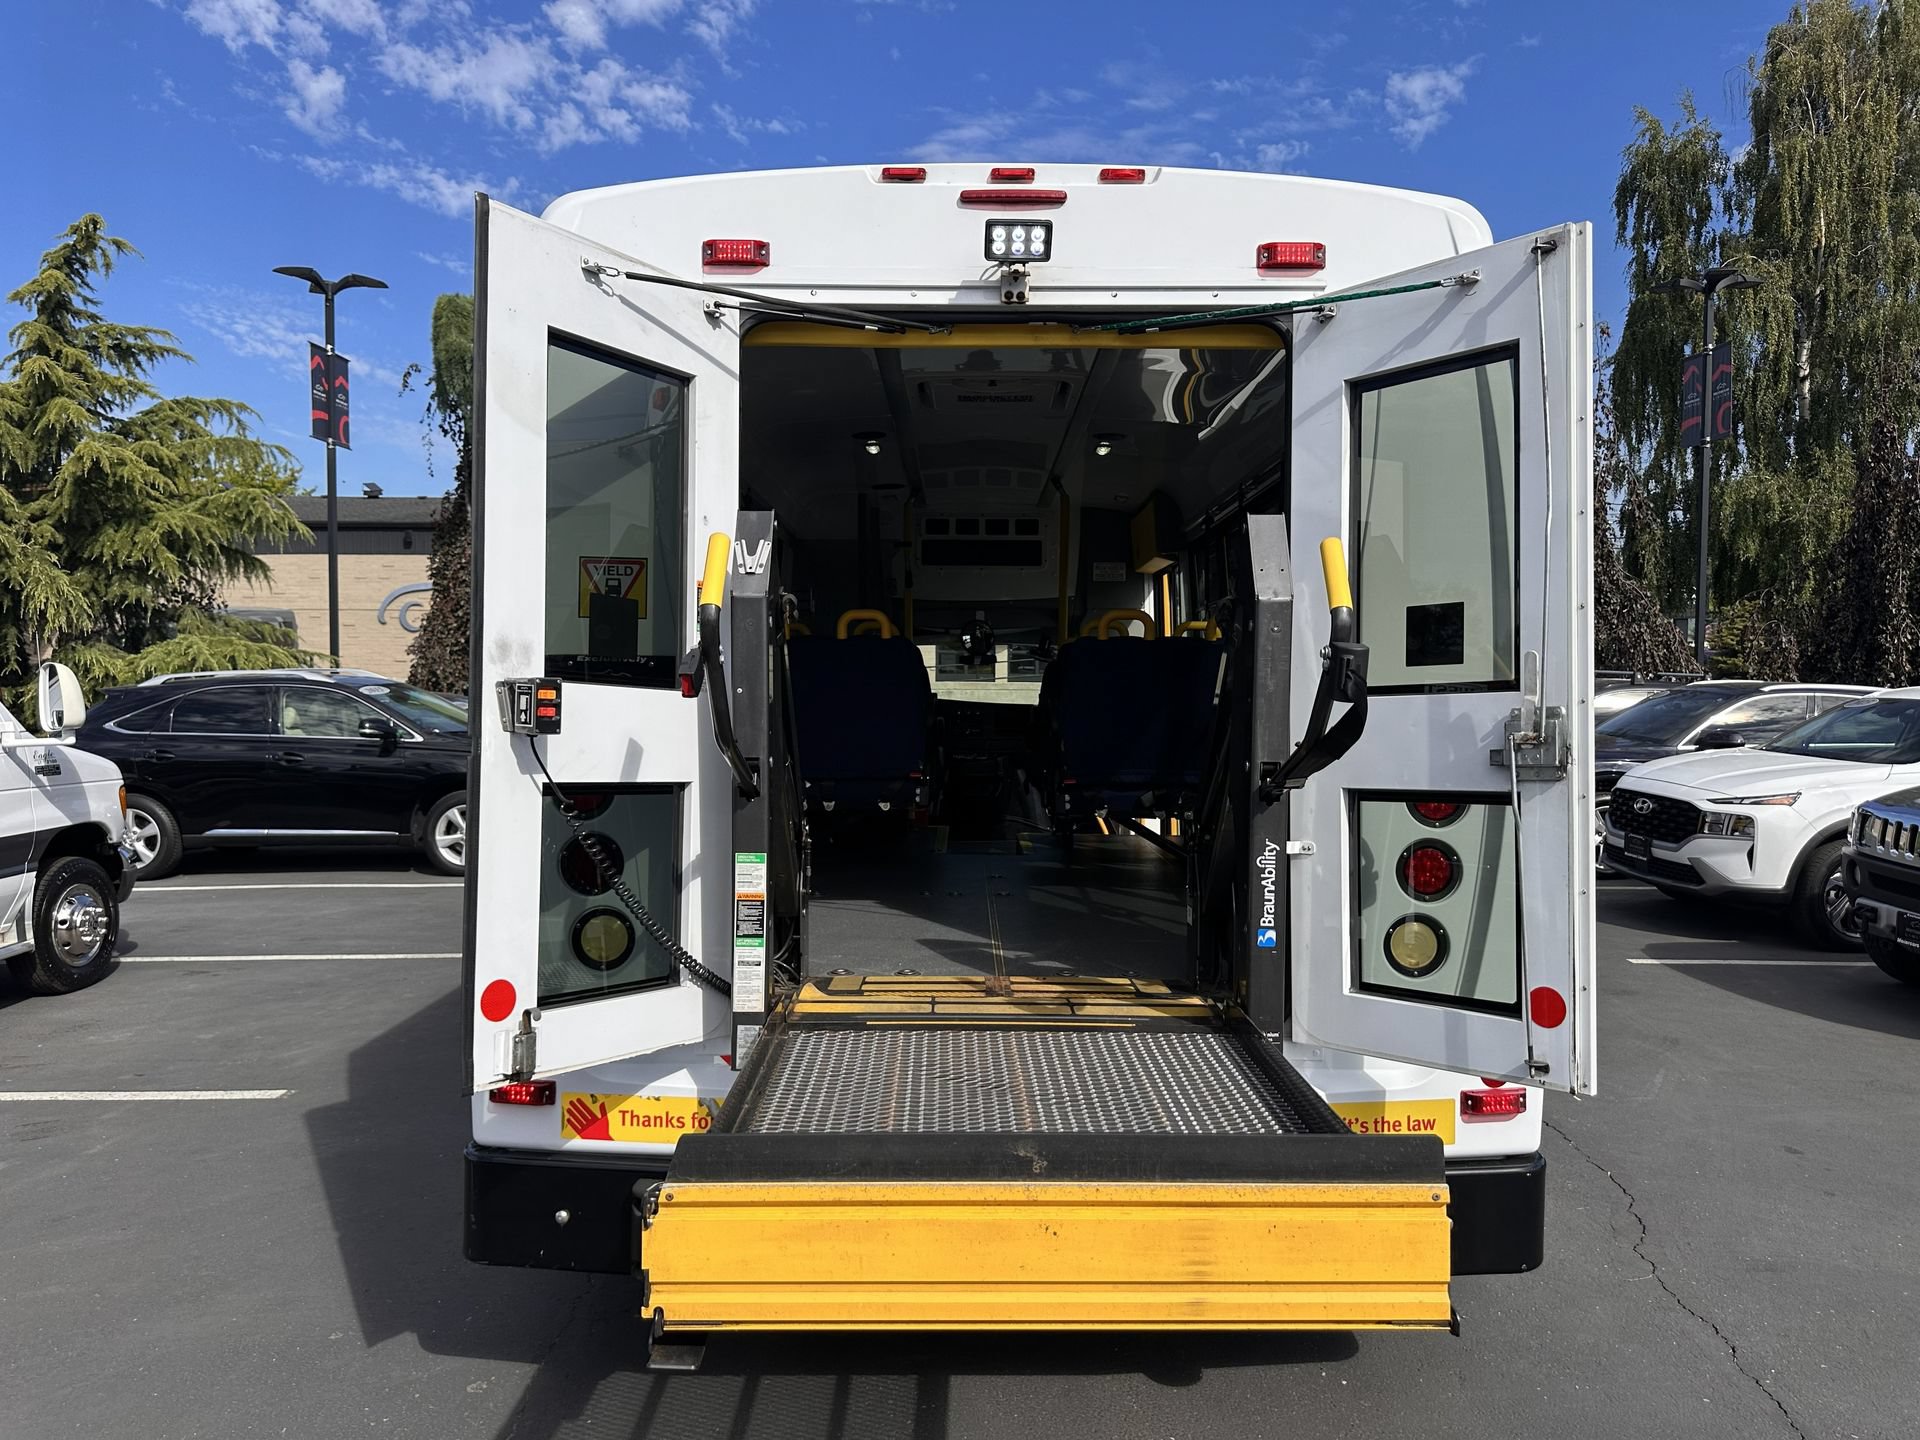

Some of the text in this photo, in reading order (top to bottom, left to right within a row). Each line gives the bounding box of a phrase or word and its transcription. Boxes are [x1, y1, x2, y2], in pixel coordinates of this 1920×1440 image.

[593, 565, 634, 576] YIELD
[1256, 838, 1280, 927] BraunAbility
[618, 1109, 710, 1130] Thanks fo
[1373, 1115, 1402, 1133] the
[1407, 1114, 1437, 1132] law
